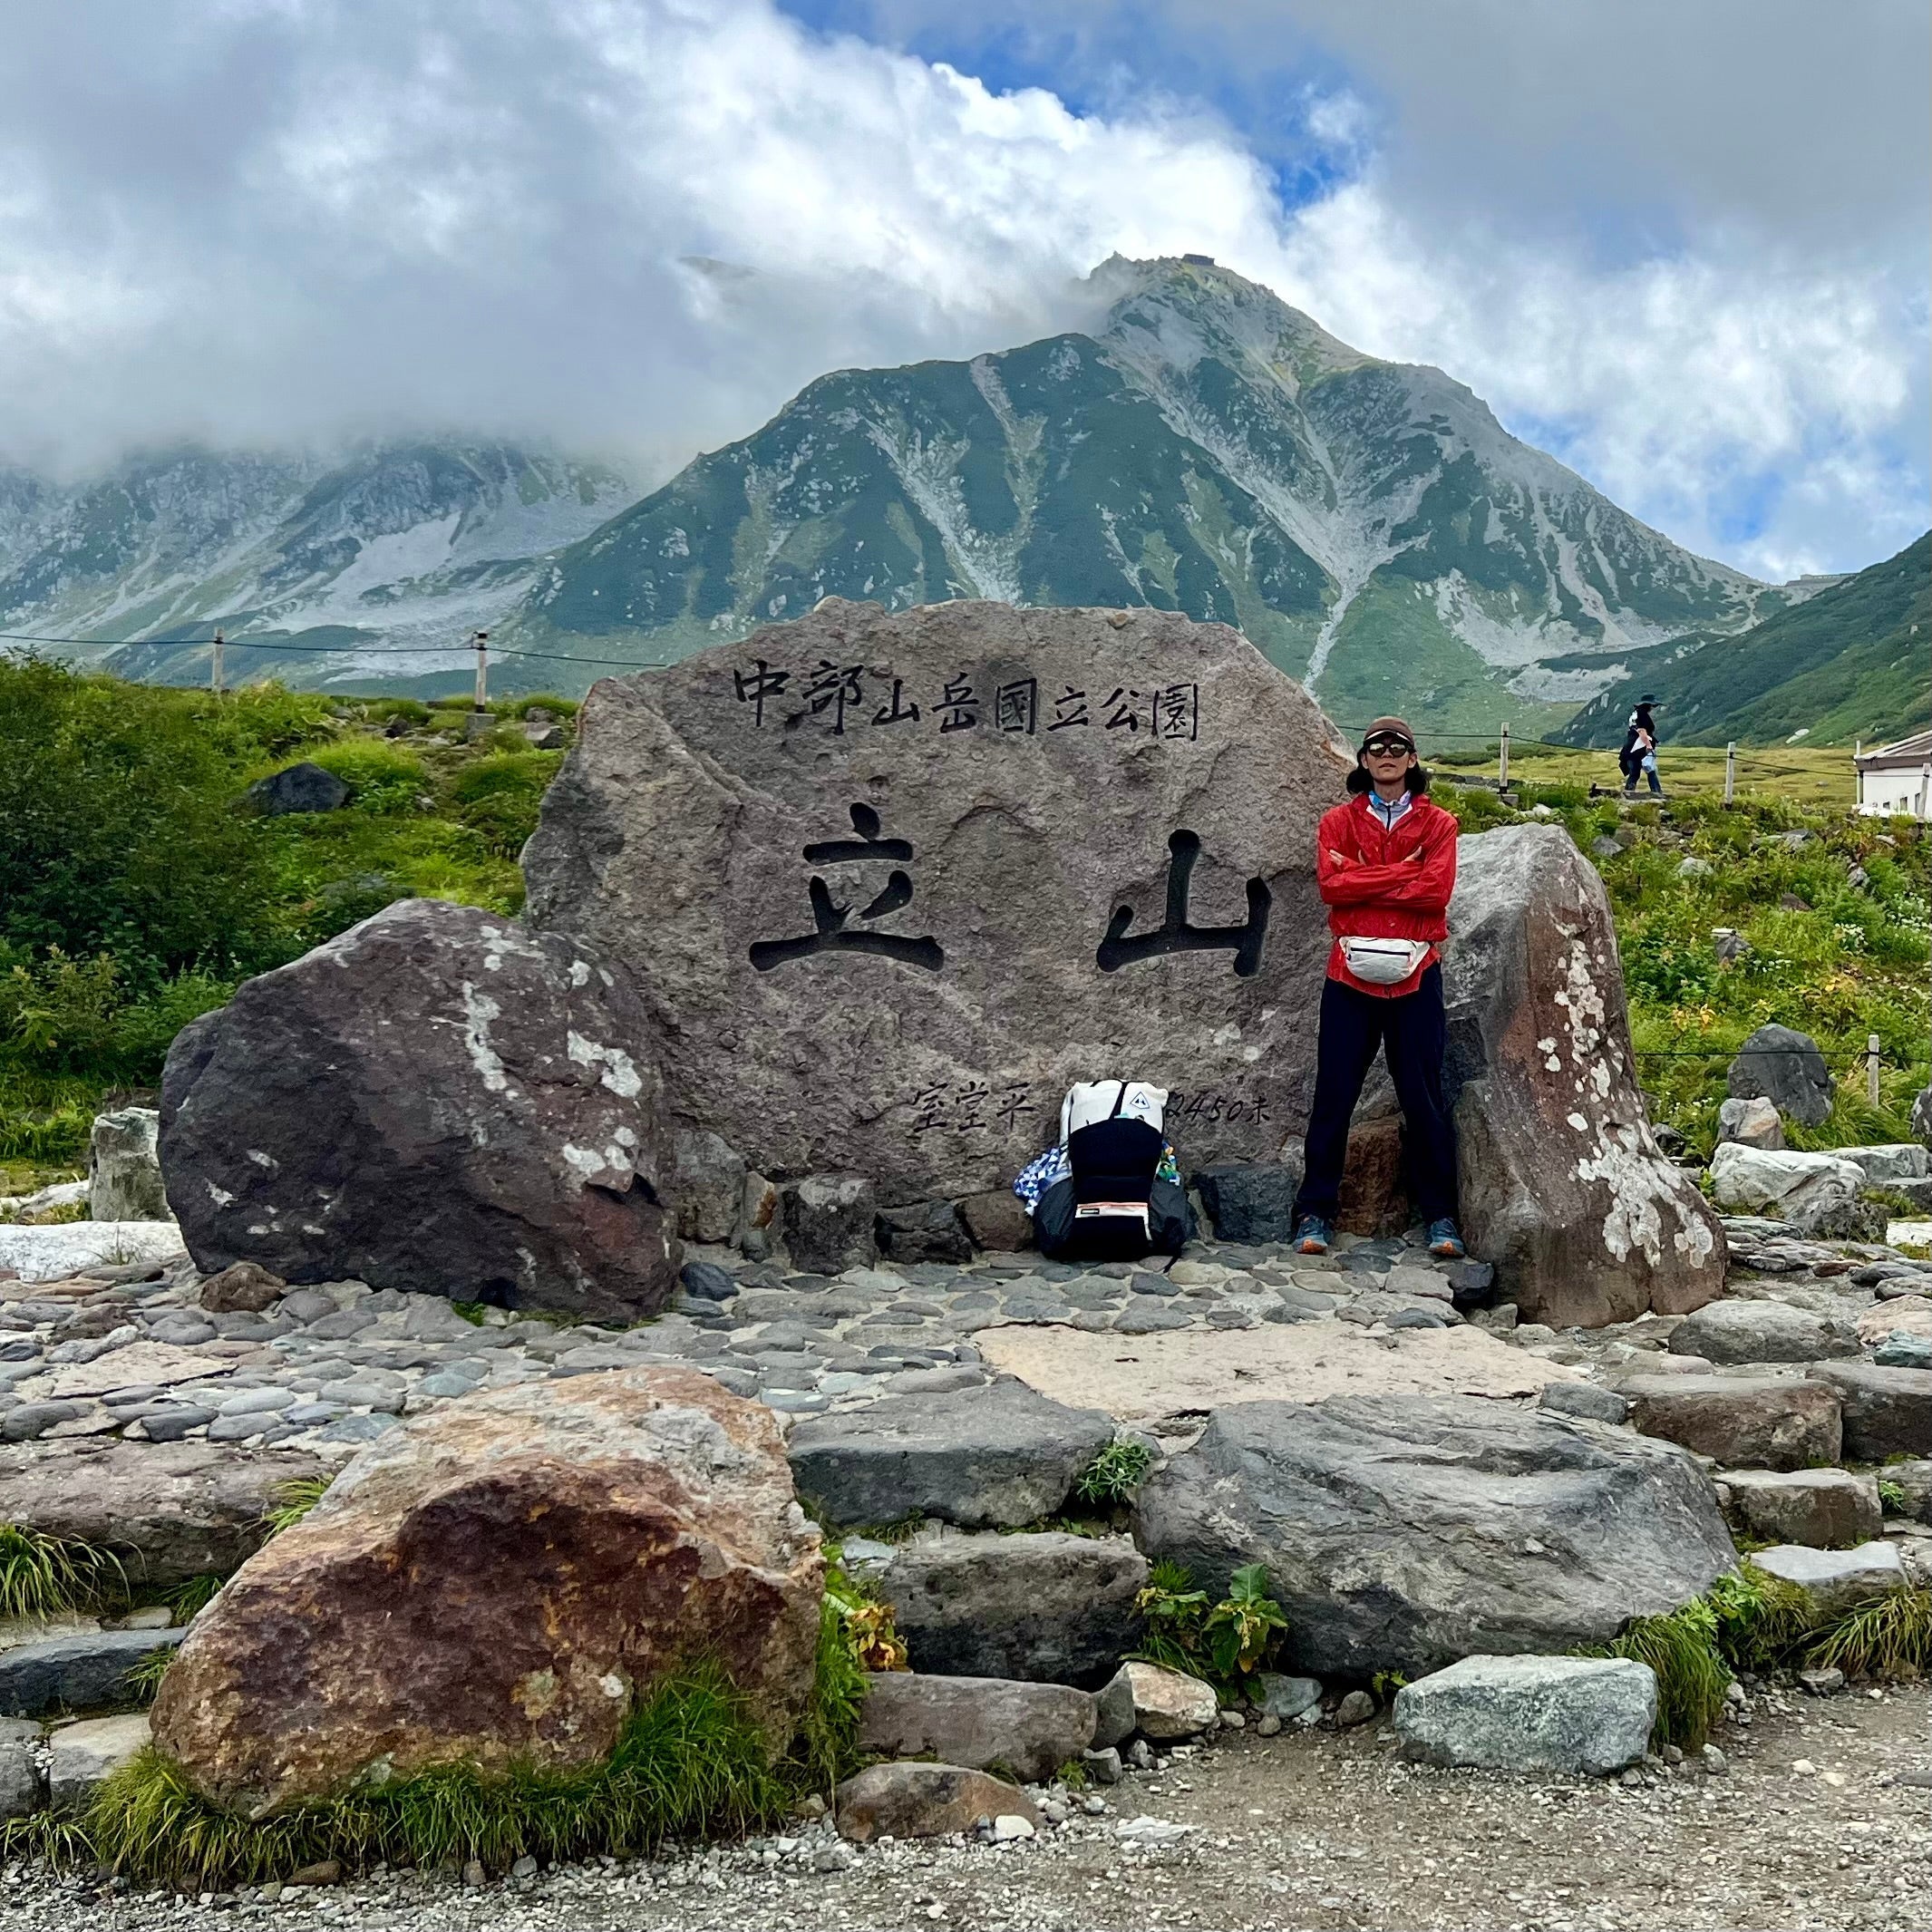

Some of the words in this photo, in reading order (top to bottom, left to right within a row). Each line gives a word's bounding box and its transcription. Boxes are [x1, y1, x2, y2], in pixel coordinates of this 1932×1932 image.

[733, 659, 1199, 742] 中部山岳國立公園
[750, 801, 1271, 976] 立山
[914, 1081, 1035, 1132] 室堂平
